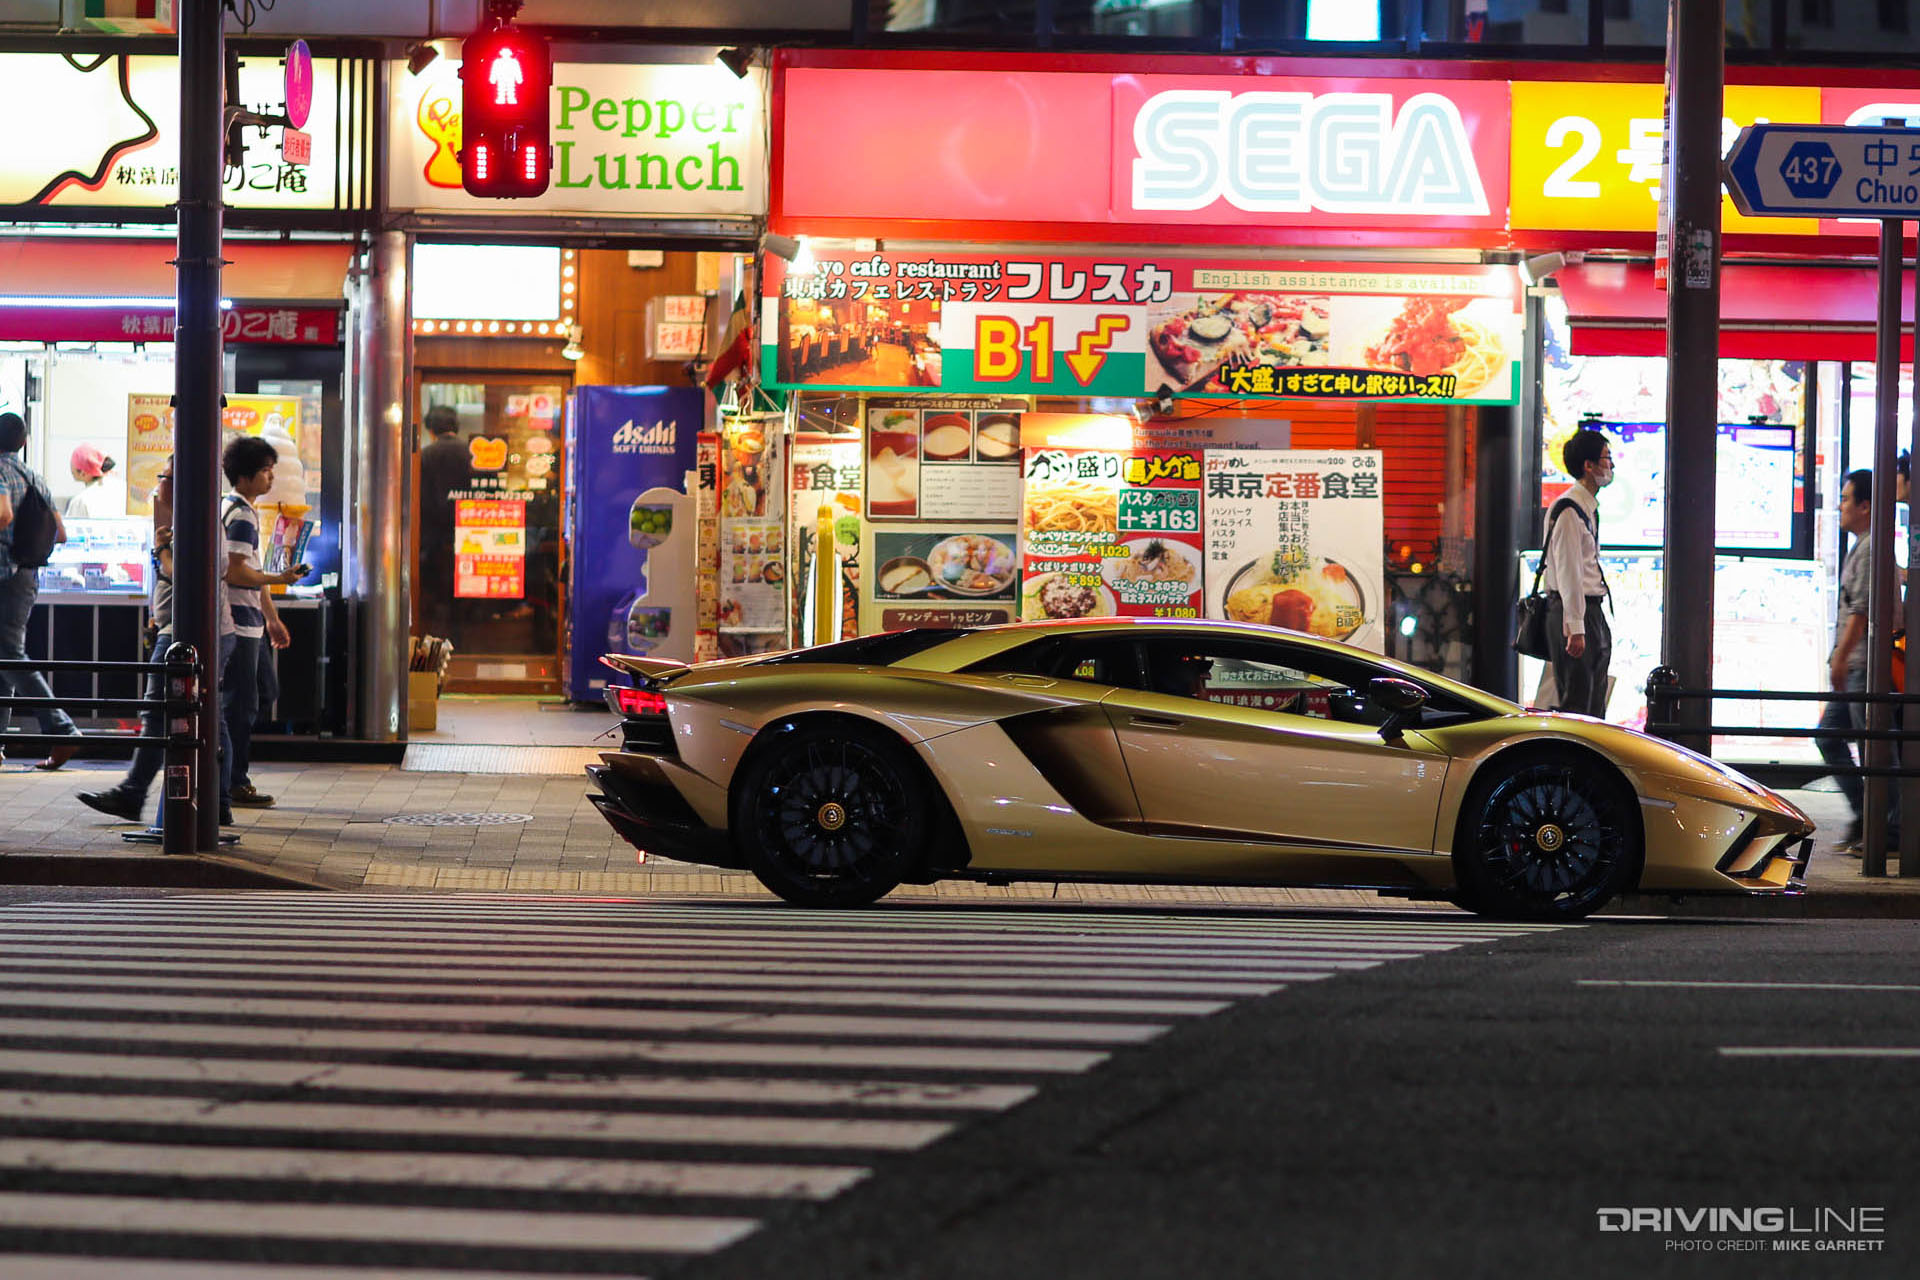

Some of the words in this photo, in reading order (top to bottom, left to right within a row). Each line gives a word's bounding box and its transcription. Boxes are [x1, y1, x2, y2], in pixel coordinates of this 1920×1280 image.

[555, 86, 744, 137] Pepper
[1131, 89, 1491, 216] SEGA
[555, 140, 744, 191] Lunch
[1785, 156, 1837, 185] 437
[1856, 177, 1918, 204] Chuo
[850, 256, 890, 277] cafe
[897, 259, 1002, 279] restaurant
[784, 276, 1003, 302] 東京カフェレストラン
[1005, 261, 1173, 303] フレスカ
[1202, 272, 1270, 287] English
[1279, 275, 1377, 290] assistance
[1384, 276, 1402, 289] is
[974, 315, 1054, 383] B1
[613, 419, 677, 446] Asahi
[613, 445, 638, 454] SOFT
[639, 445, 675, 454] DRINKS
[1145, 439, 1160, 449] the
[1164, 439, 1184, 449] first
[1186, 440, 1233, 450] basement
[1236, 440, 1262, 450] level.
[1352, 456, 1377, 469] ぴあ
[1207, 472, 1379, 500] 東京定番食堂
[1211, 507, 1253, 516] ハンバーグ
[1211, 518, 1253, 528] オムライス
[1211, 529, 1236, 538] パスタ
[1211, 540, 1236, 549] 丼ぶり
[1211, 551, 1229, 561] 定食
[1068, 575, 1102, 587] ¥893
